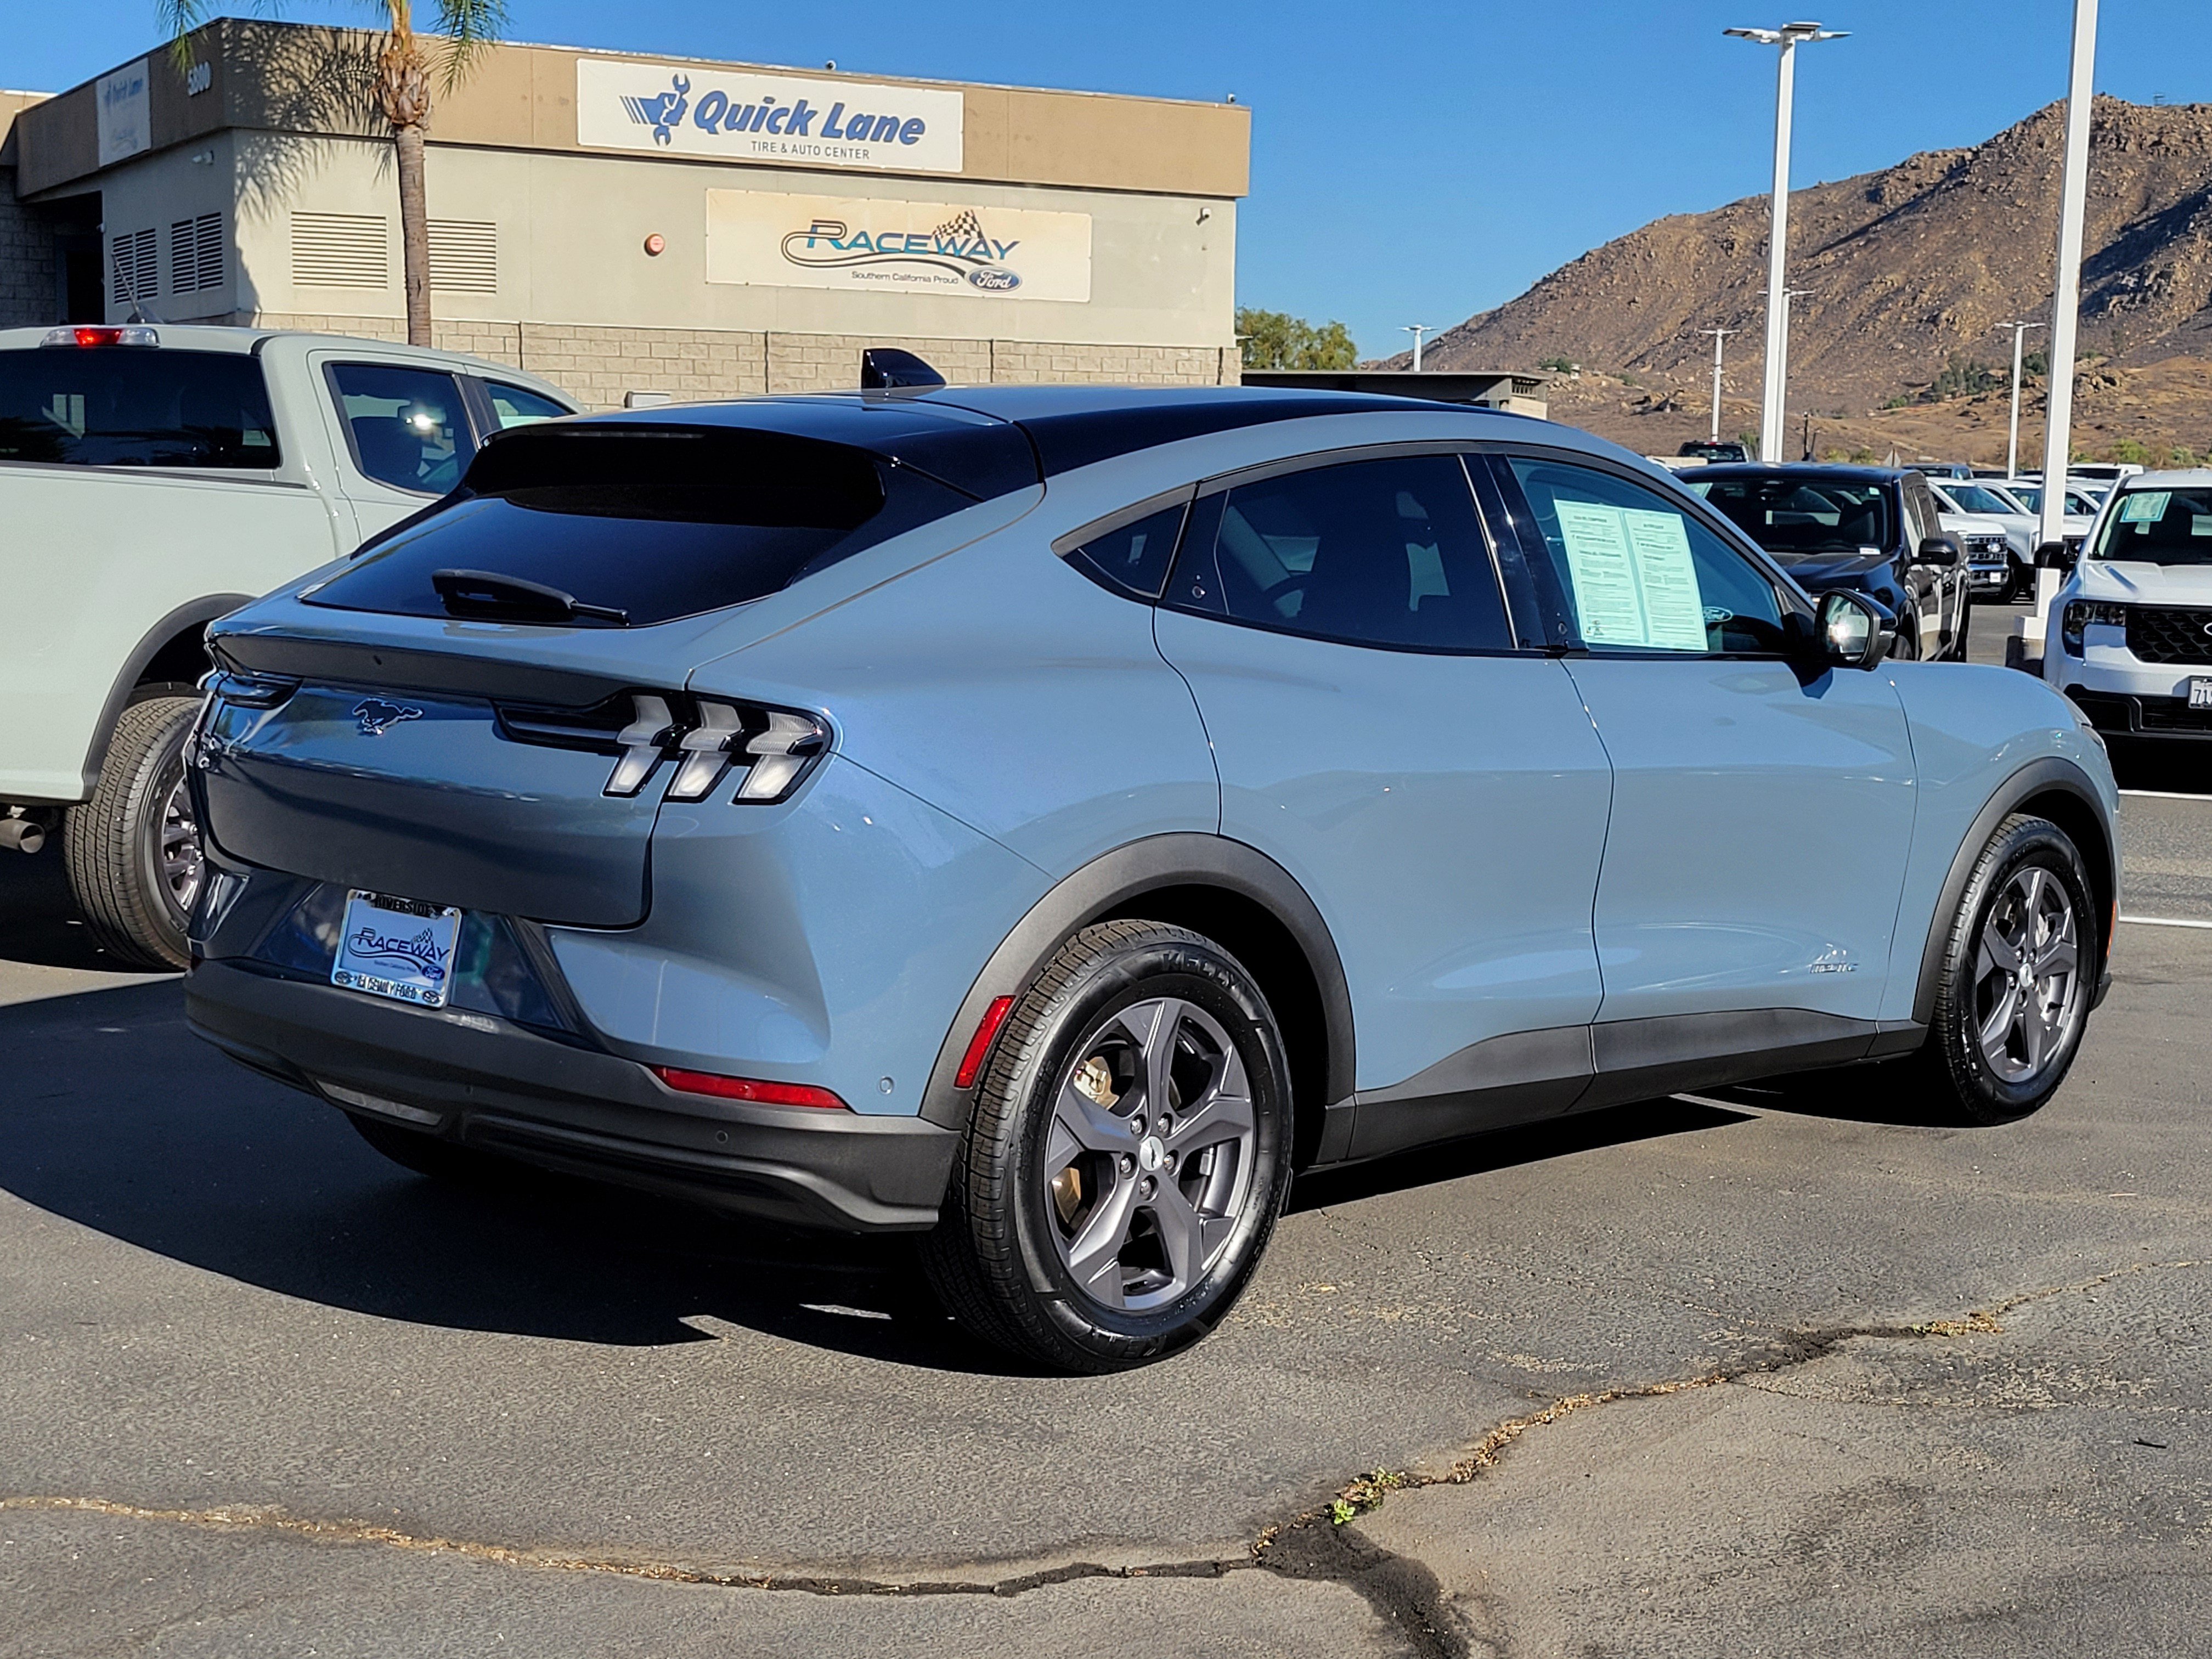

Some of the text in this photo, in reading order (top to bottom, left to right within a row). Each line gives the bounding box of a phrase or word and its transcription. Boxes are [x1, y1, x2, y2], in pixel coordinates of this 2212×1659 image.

[693, 90, 926, 145] Quick Lane
[751, 140, 870, 160] TIRE & AUTO CENTER
[806, 219, 1020, 260] RACEWAY
[851, 270, 958, 284] Southern California Proud
[976, 269, 1012, 289] Ford
[2194, 689, 2212, 704] 71
[358, 927, 450, 961] RACEWAY
